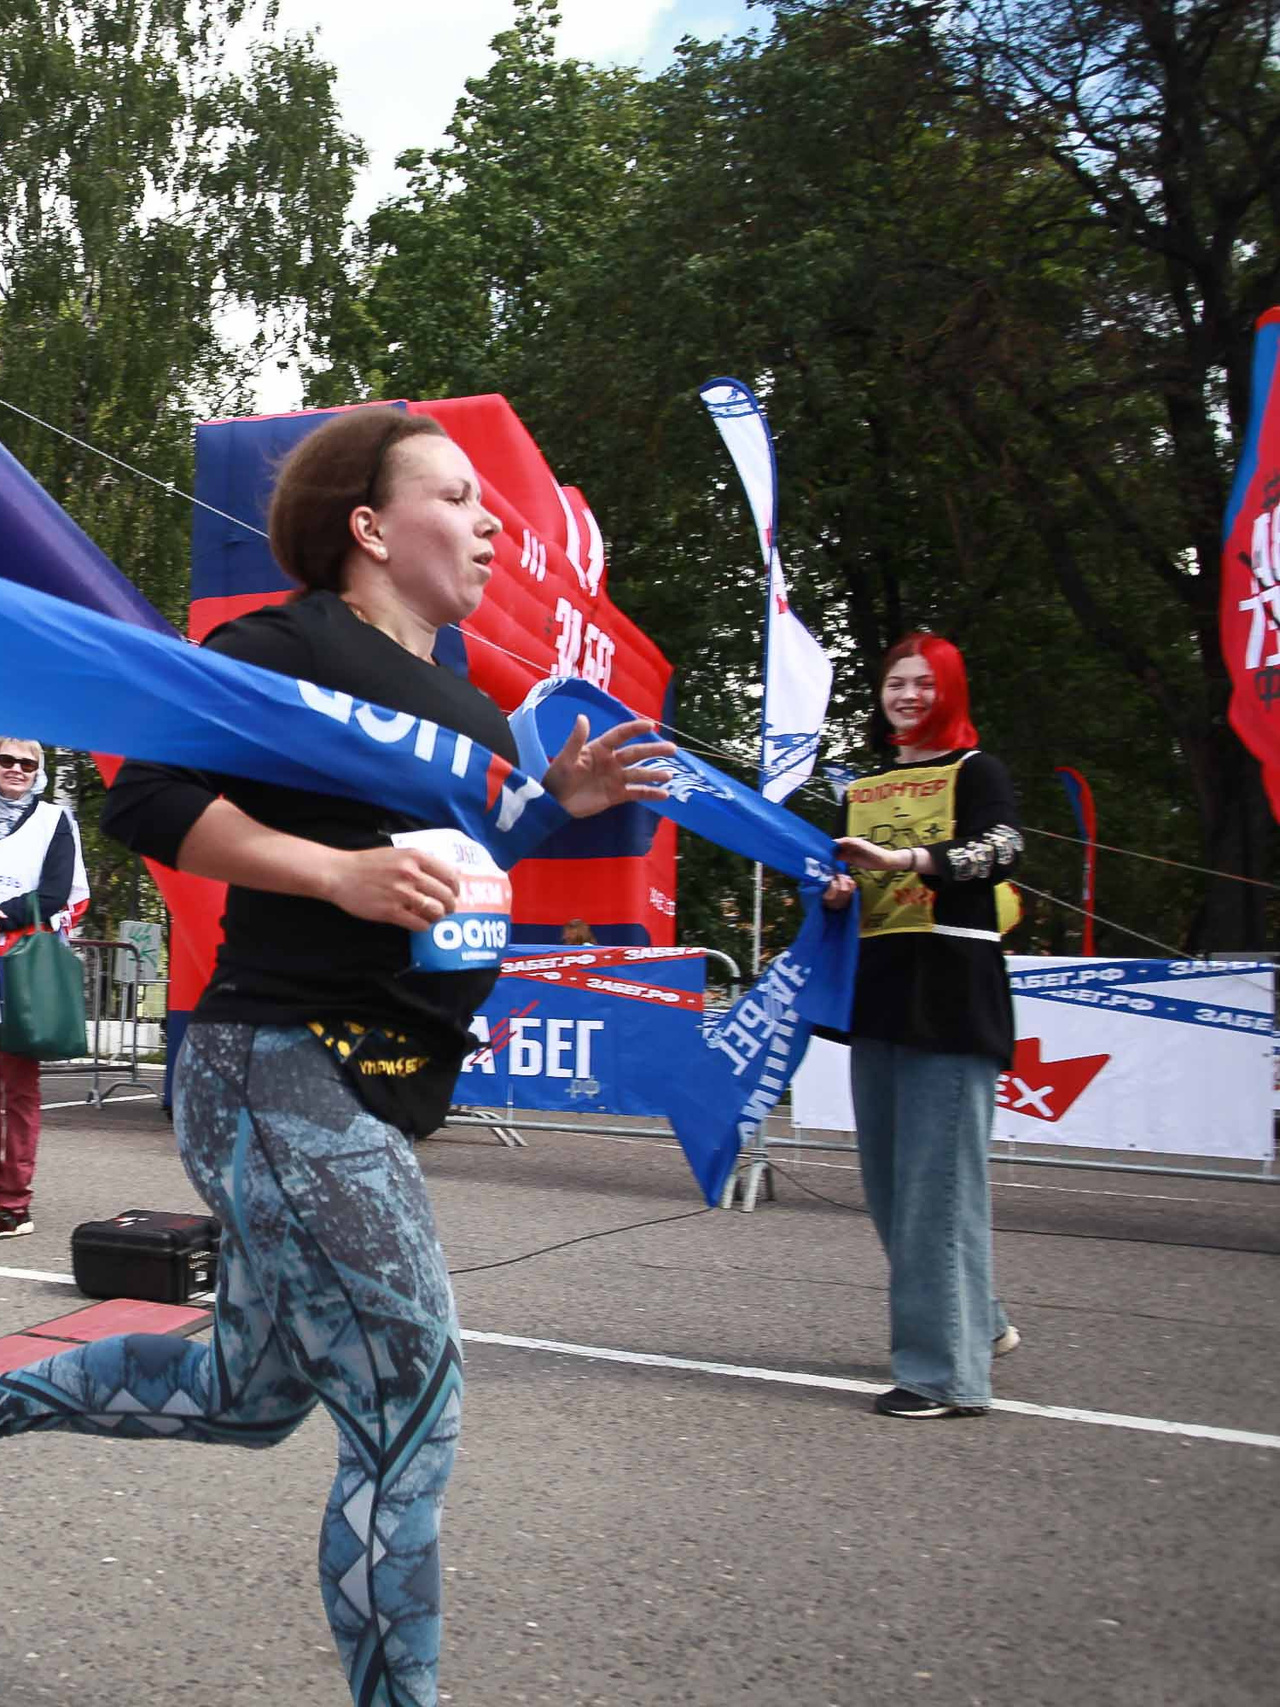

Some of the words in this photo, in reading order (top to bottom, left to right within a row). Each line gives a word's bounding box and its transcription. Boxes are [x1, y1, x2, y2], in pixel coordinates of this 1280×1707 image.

[432, 918, 508, 950] 00113
[500, 953, 597, 974] ЗАБЕГ.РФ
[586, 977, 681, 1003] ЗАБЕГ.РФ
[1009, 967, 1126, 990] АБЕГ.РФ
